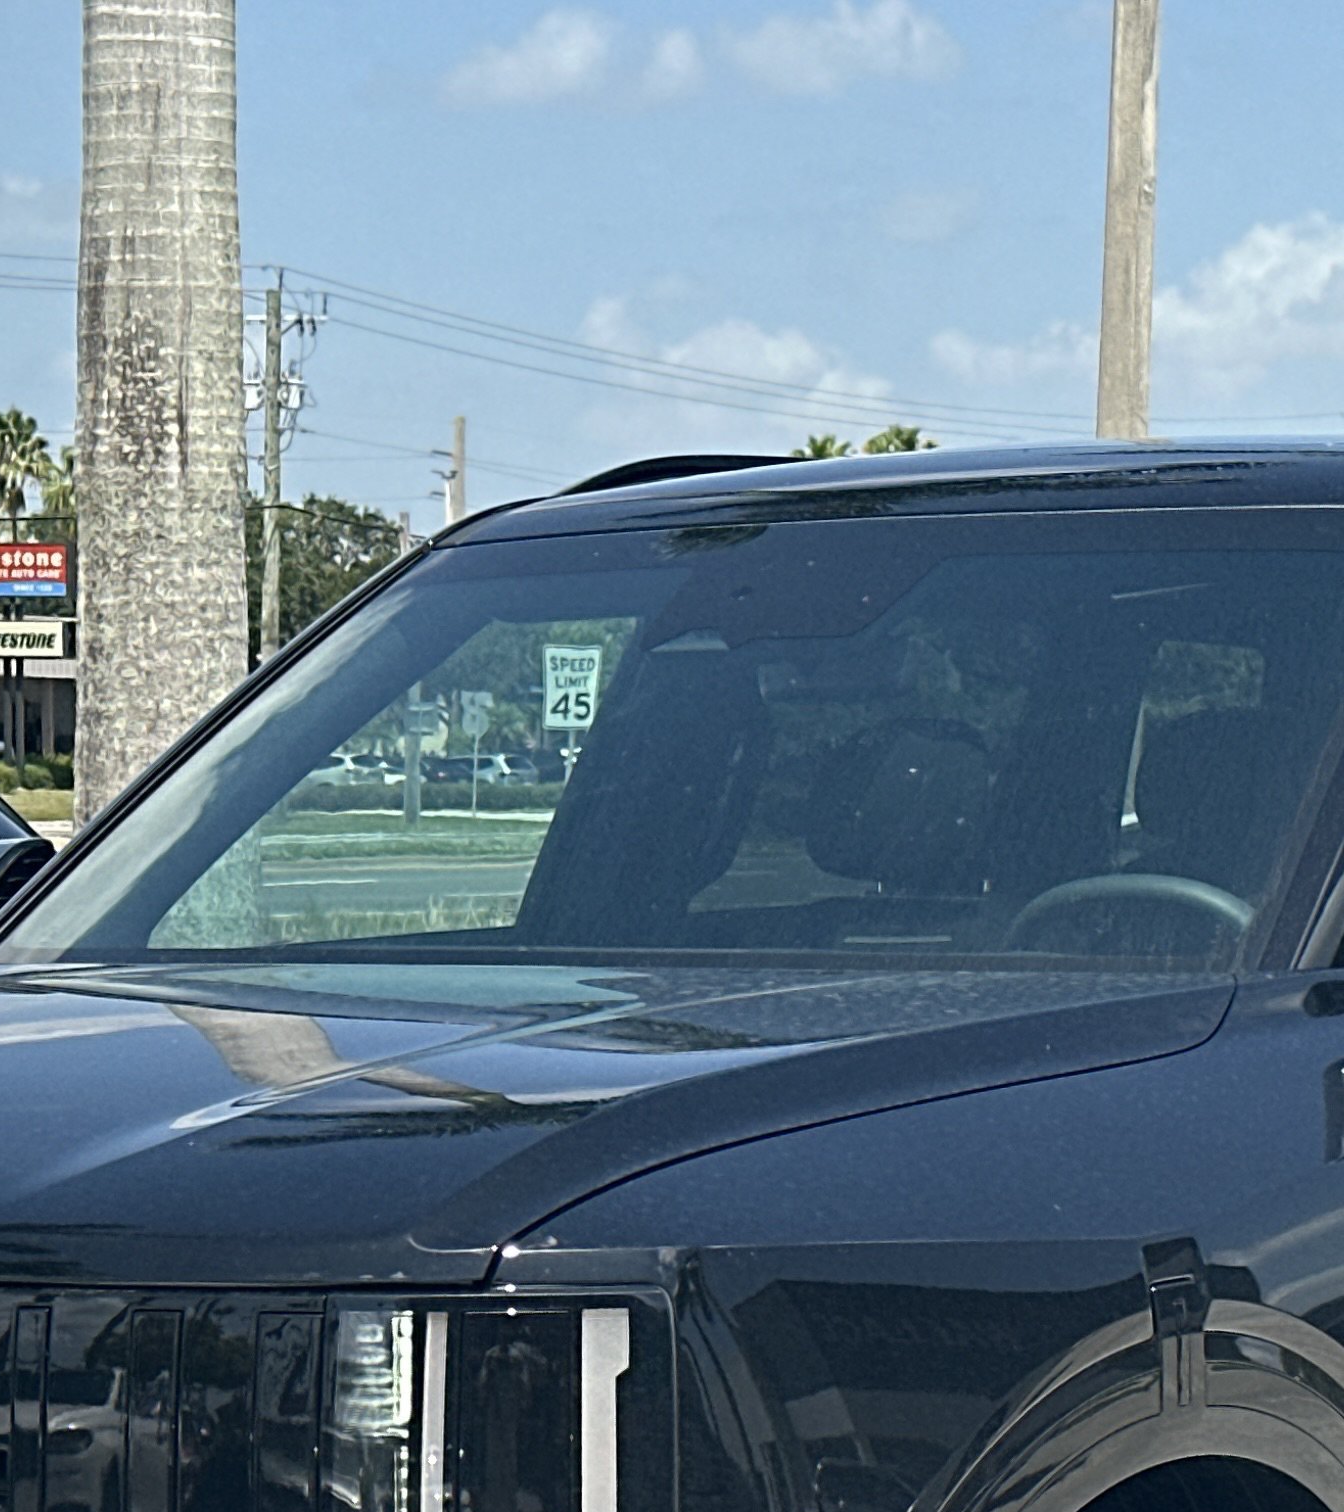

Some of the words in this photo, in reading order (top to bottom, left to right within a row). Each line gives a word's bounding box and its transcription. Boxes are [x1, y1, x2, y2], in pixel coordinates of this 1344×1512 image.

[11, 569, 35, 578] AUTO
[549, 656, 596, 672] SPEED
[554, 676, 589, 688] LIMIT
[550, 692, 591, 720] 45
